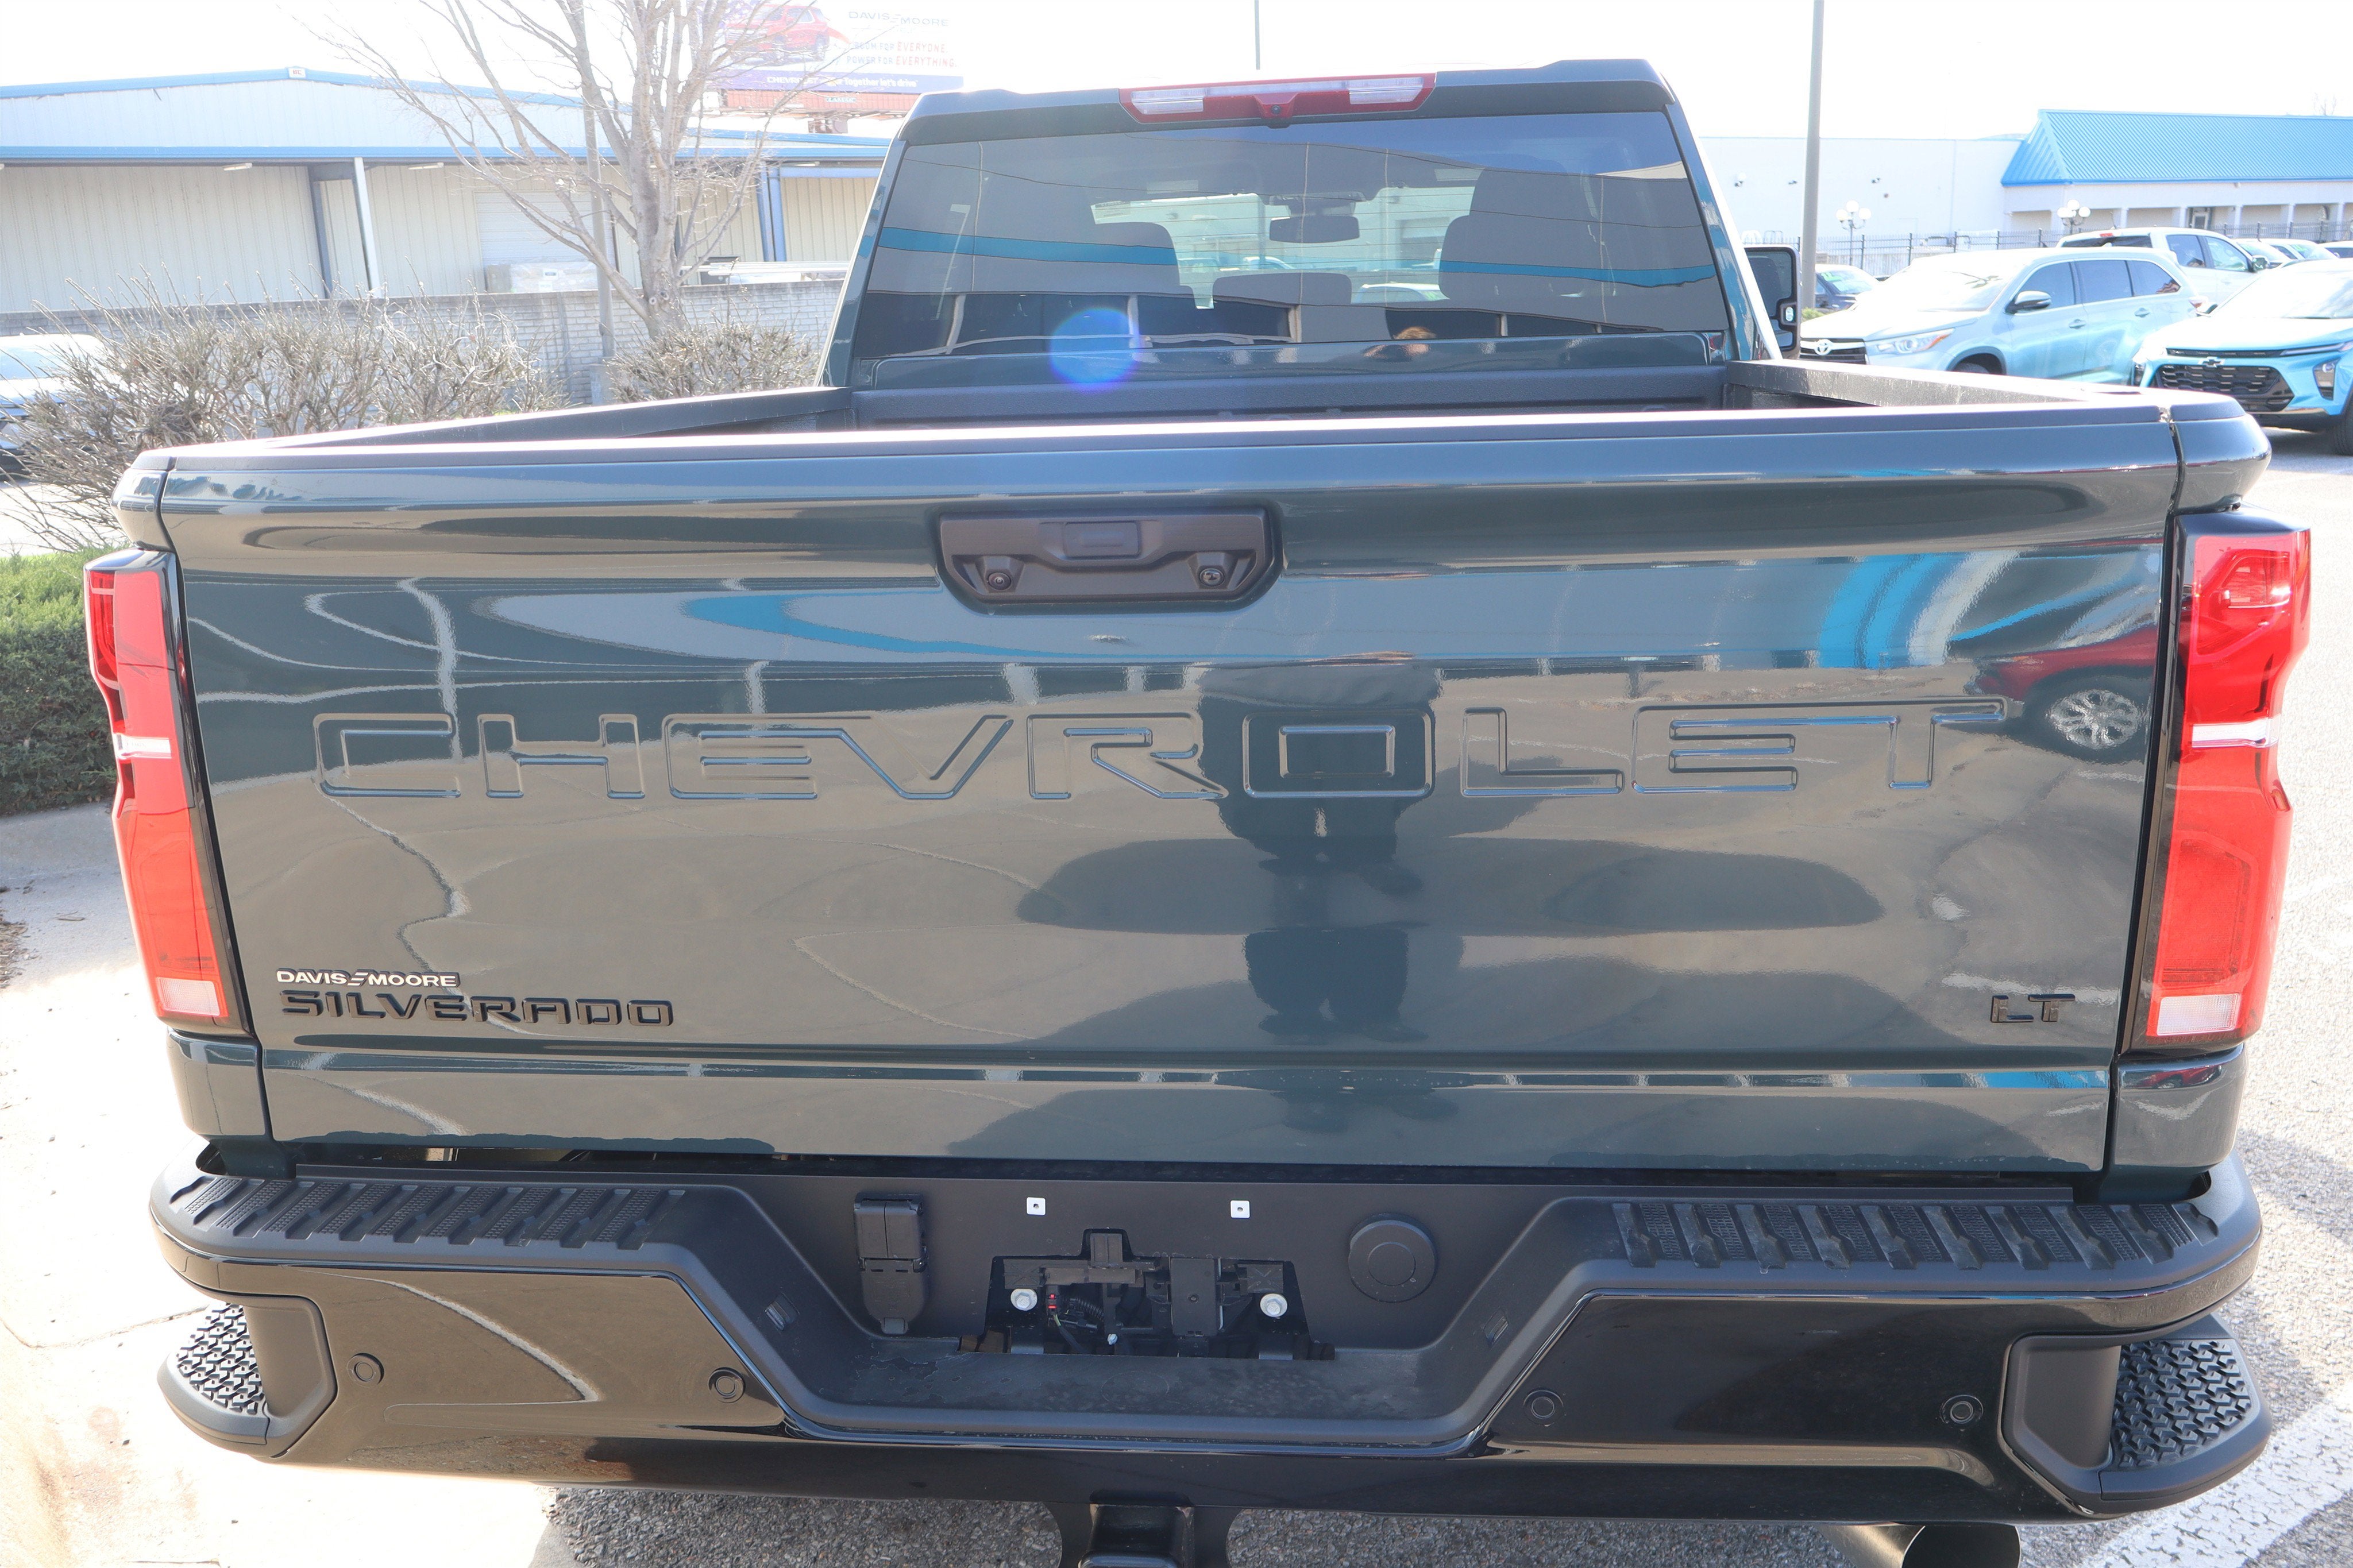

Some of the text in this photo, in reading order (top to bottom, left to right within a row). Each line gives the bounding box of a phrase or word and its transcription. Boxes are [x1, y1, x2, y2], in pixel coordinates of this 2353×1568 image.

[880, 42, 896, 51] FOR
[897, 41, 948, 53] EVERYONE.
[846, 56, 958, 67] POWER FOR EVERYTHING.
[844, 77, 879, 87] Together
[897, 79, 917, 88] drive
[313, 696, 2008, 800] CHEVROLET
[280, 990, 674, 1026] SILVERADO
[1991, 994, 2076, 1023] LT
